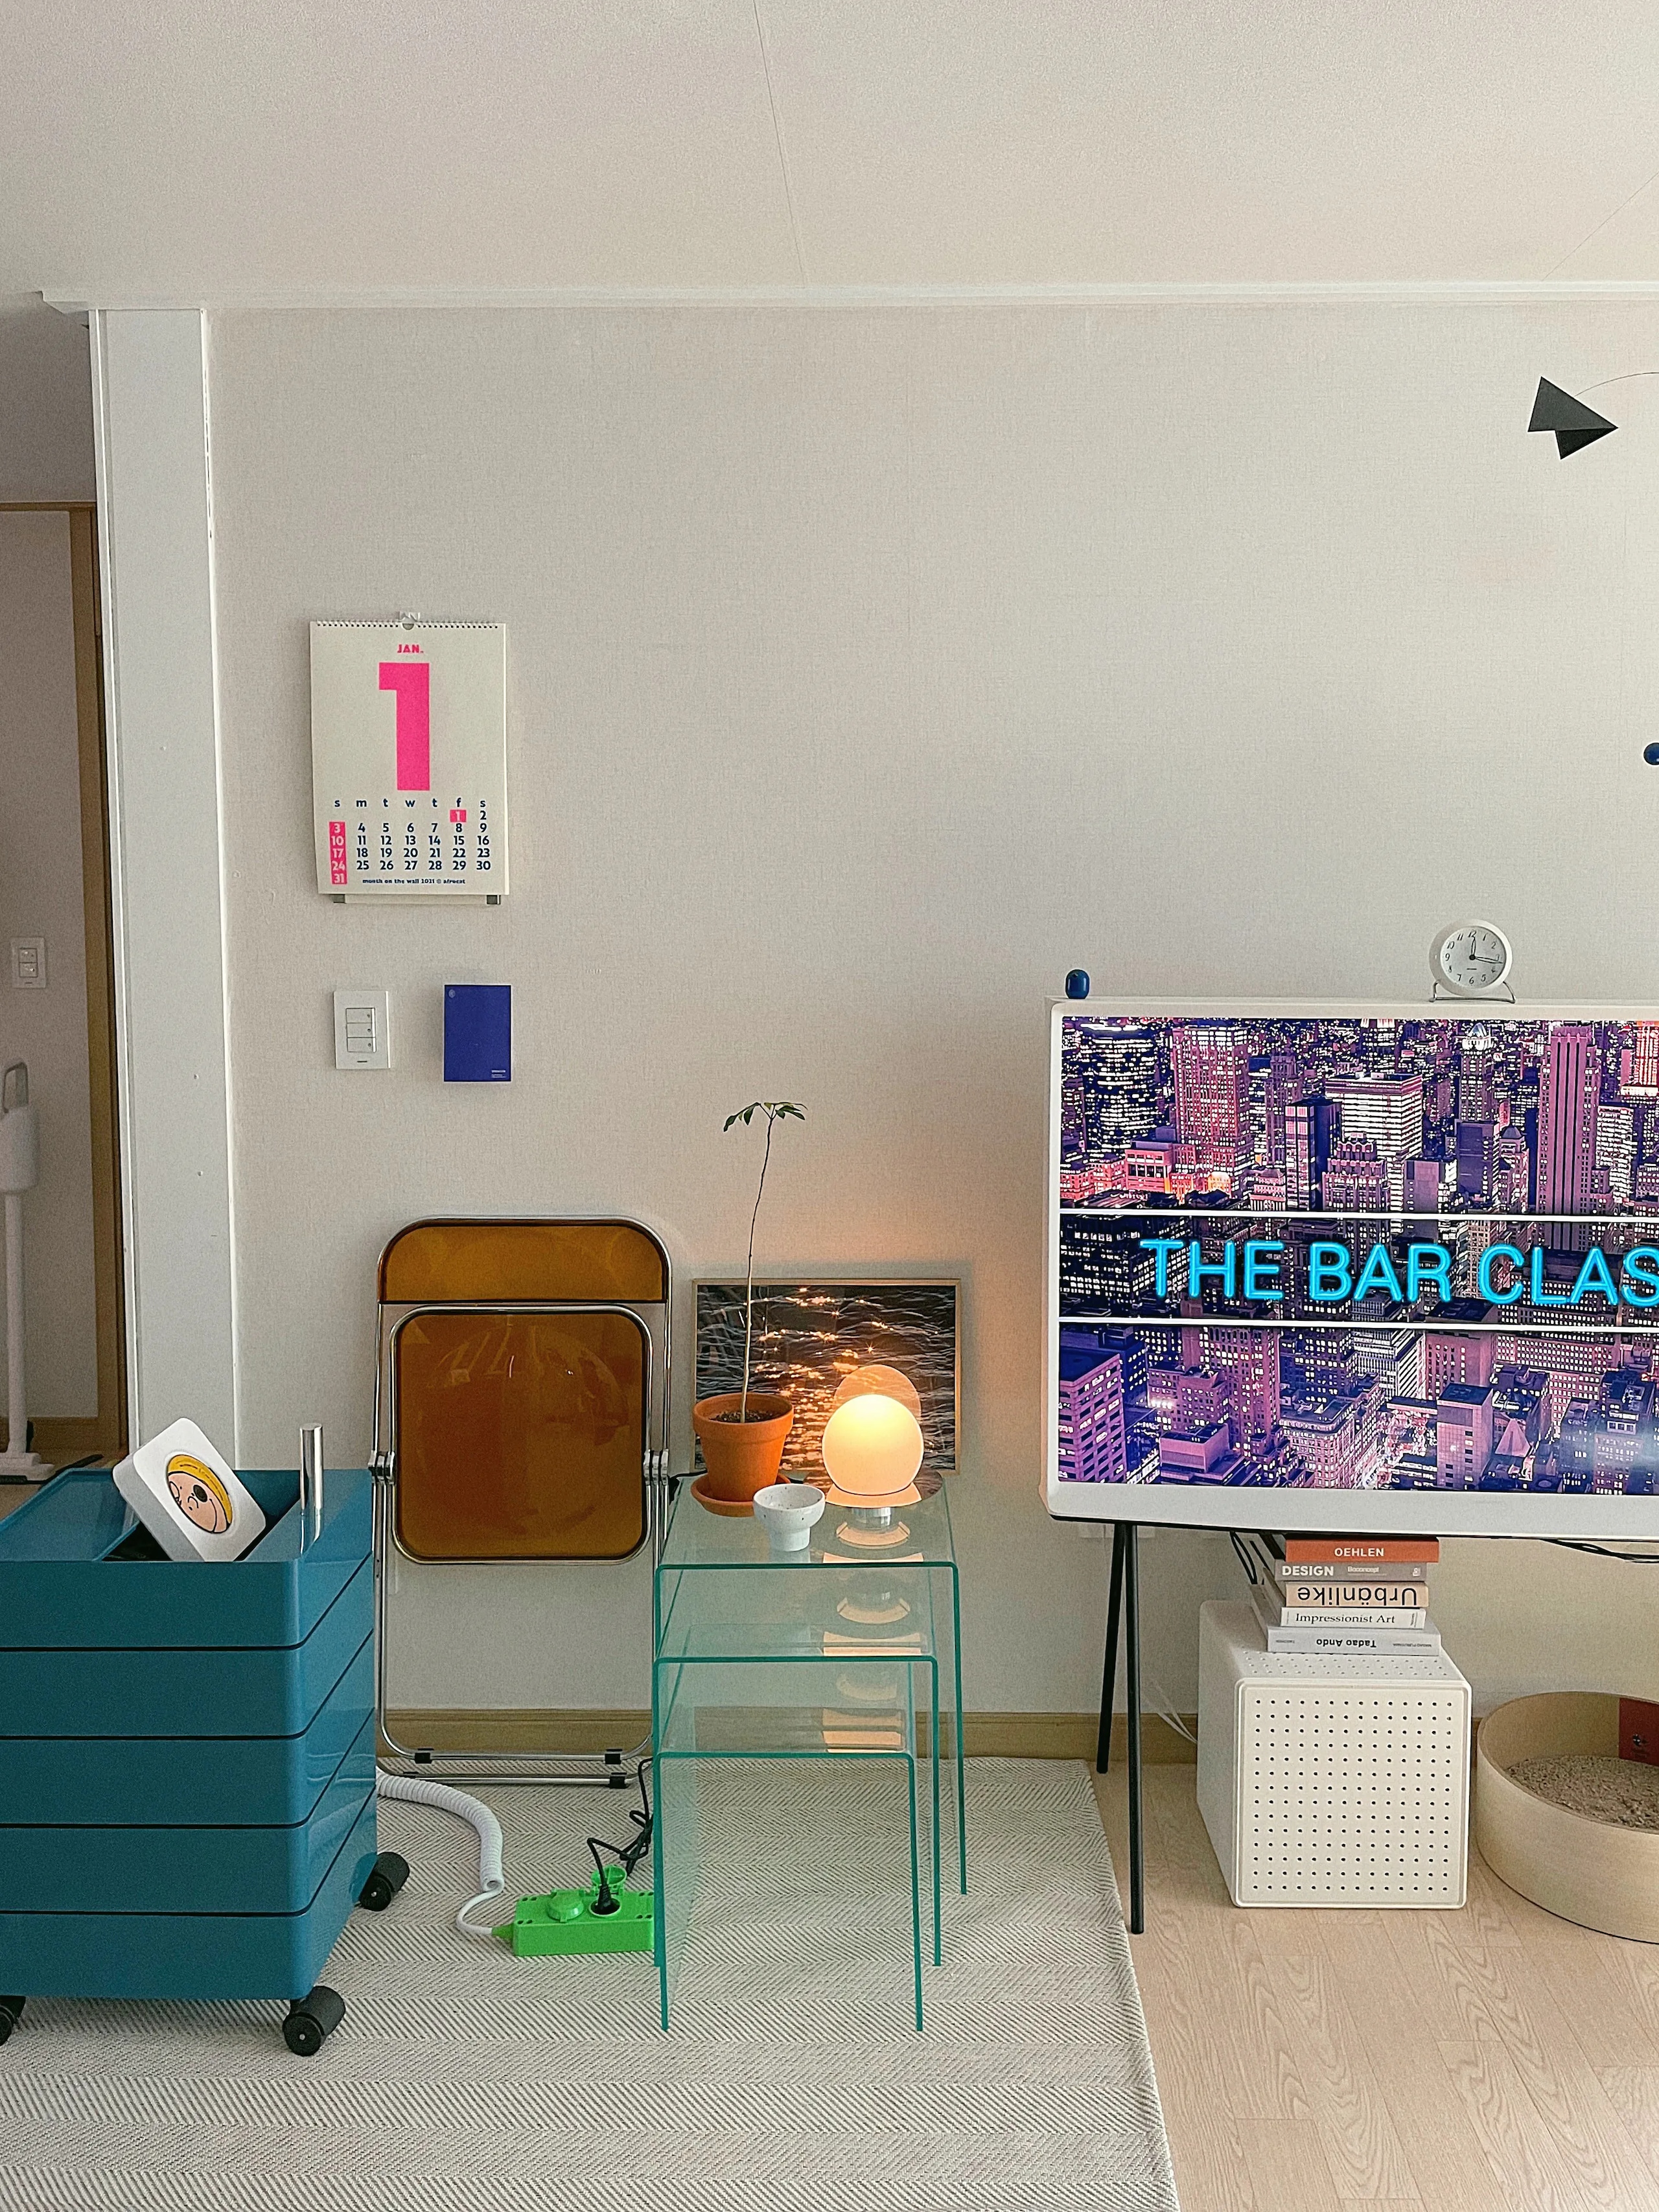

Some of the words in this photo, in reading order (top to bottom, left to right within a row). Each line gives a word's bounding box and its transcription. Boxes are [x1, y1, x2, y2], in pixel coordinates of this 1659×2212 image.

[397, 644, 423, 653] JAN.
[378, 662, 430, 791] 1
[383, 798, 388, 808] t
[432, 798, 437, 808] t
[456, 797, 461, 808] f
[455, 811, 461, 821] 1
[480, 810, 487, 821] 2
[334, 822, 341, 833] 3
[358, 822, 365, 833] 4
[382, 822, 389, 833] 5
[407, 822, 414, 833] 6
[431, 822, 438, 833] 7
[456, 822, 463, 833] 8
[480, 822, 487, 833] 9
[331, 835, 344, 846] 10
[357, 835, 366, 845] 11
[380, 835, 392, 845] 12
[405, 835, 416, 845] 13
[428, 835, 441, 845] 14
[453, 835, 465, 845] 15
[477, 835, 490, 845] 16
[332, 848, 344, 858] 17
[356, 847, 368, 857] 18
[380, 848, 393, 858] 19
[403, 848, 418, 857] 20
[429, 848, 440, 858] 21
[452, 848, 466, 858] 22
[477, 848, 490, 858] 23
[332, 861, 345, 870] 24
[356, 860, 369, 870] 25
[379, 860, 394, 870] 26
[404, 860, 418, 870] 27
[428, 860, 442, 870] 28
[452, 860, 467, 870] 29
[476, 860, 491, 870] 30
[334, 873, 345, 883] 31
[1447, 941, 1455, 949] 10
[1139, 1237, 1284, 1301] THE
[1308, 1240, 1453, 1303] BAR
[1477, 1243, 1659, 1307] CLAS
[1334, 1548, 1384, 1557] OEHLEN
[1282, 1565, 1334, 1576] DESIGN
[1297, 1587, 1417, 1606] Urbänlike
[1295, 1613, 1373, 1625] Impressionist
[1376, 1614, 1395, 1624] Art
[1316, 1638, 1343, 1647] Ando
[1346, 1640, 1376, 1648] Tadao
